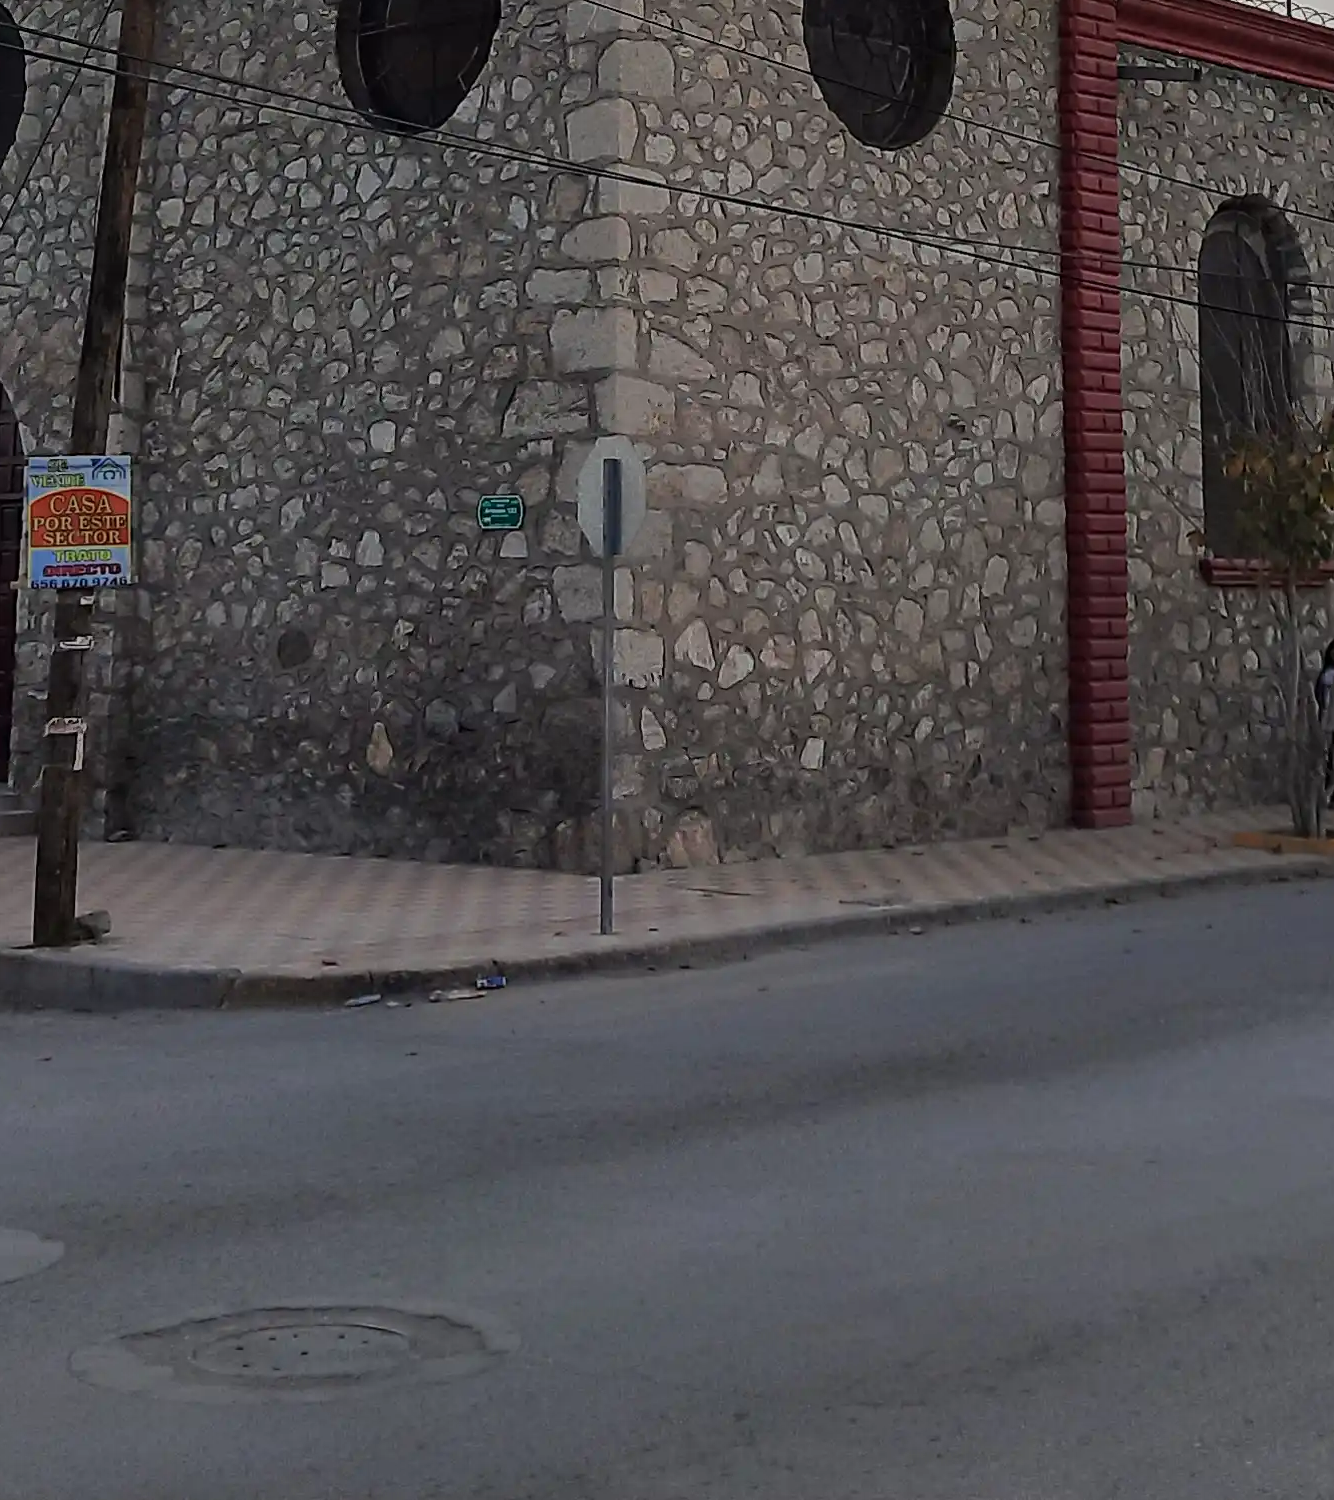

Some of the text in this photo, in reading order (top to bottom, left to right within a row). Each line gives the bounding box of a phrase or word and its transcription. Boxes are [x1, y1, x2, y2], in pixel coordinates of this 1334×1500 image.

[31, 473, 84, 487] VENDE
[50, 494, 112, 515] CASA
[33, 515, 127, 531] POR ESTE
[43, 530, 121, 546] SECTOR
[54, 549, 112, 563] TRATO
[43, 564, 121, 577] DIRECTO
